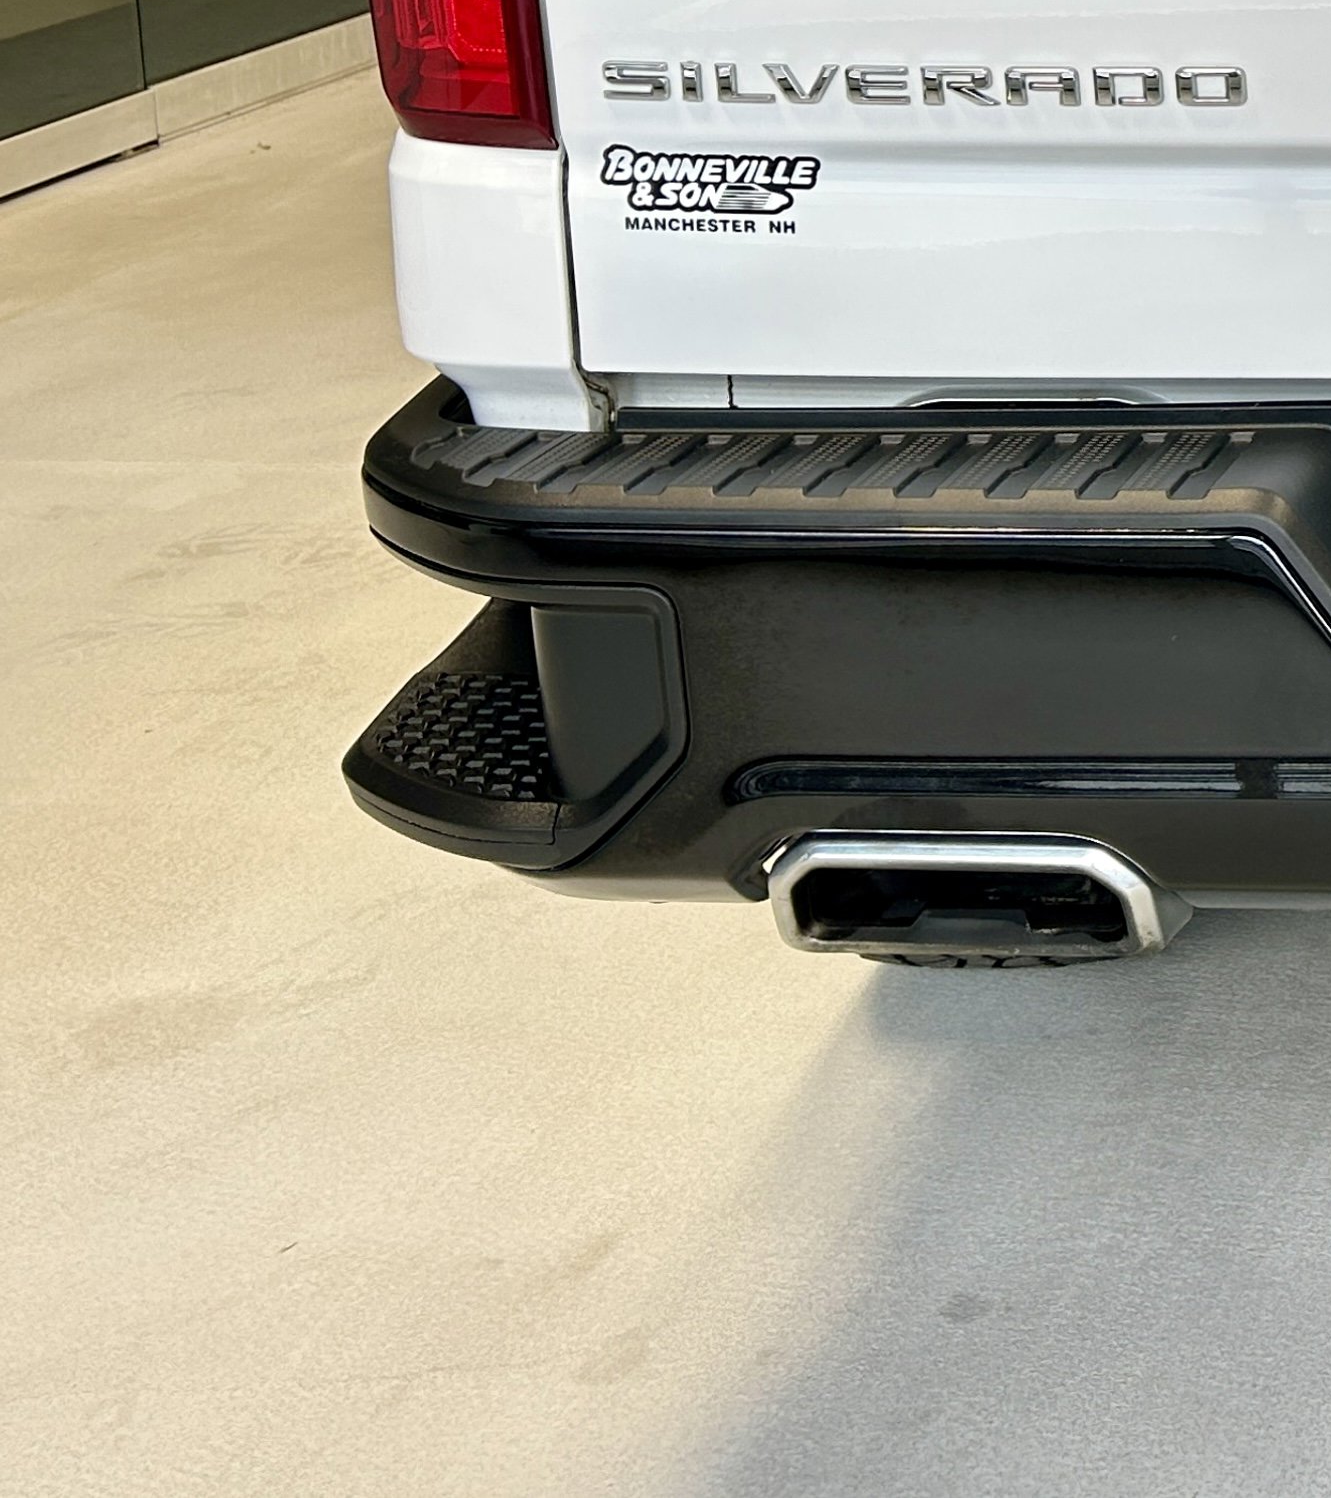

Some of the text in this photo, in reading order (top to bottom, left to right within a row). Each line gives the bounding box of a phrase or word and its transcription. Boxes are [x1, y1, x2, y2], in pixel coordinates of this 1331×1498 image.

[603, 59, 1248, 106] SILVERADO
[604, 149, 817, 185] BONNEVILLE
[632, 182, 654, 207] &
[625, 217, 796, 234] MANCHESTER NH
